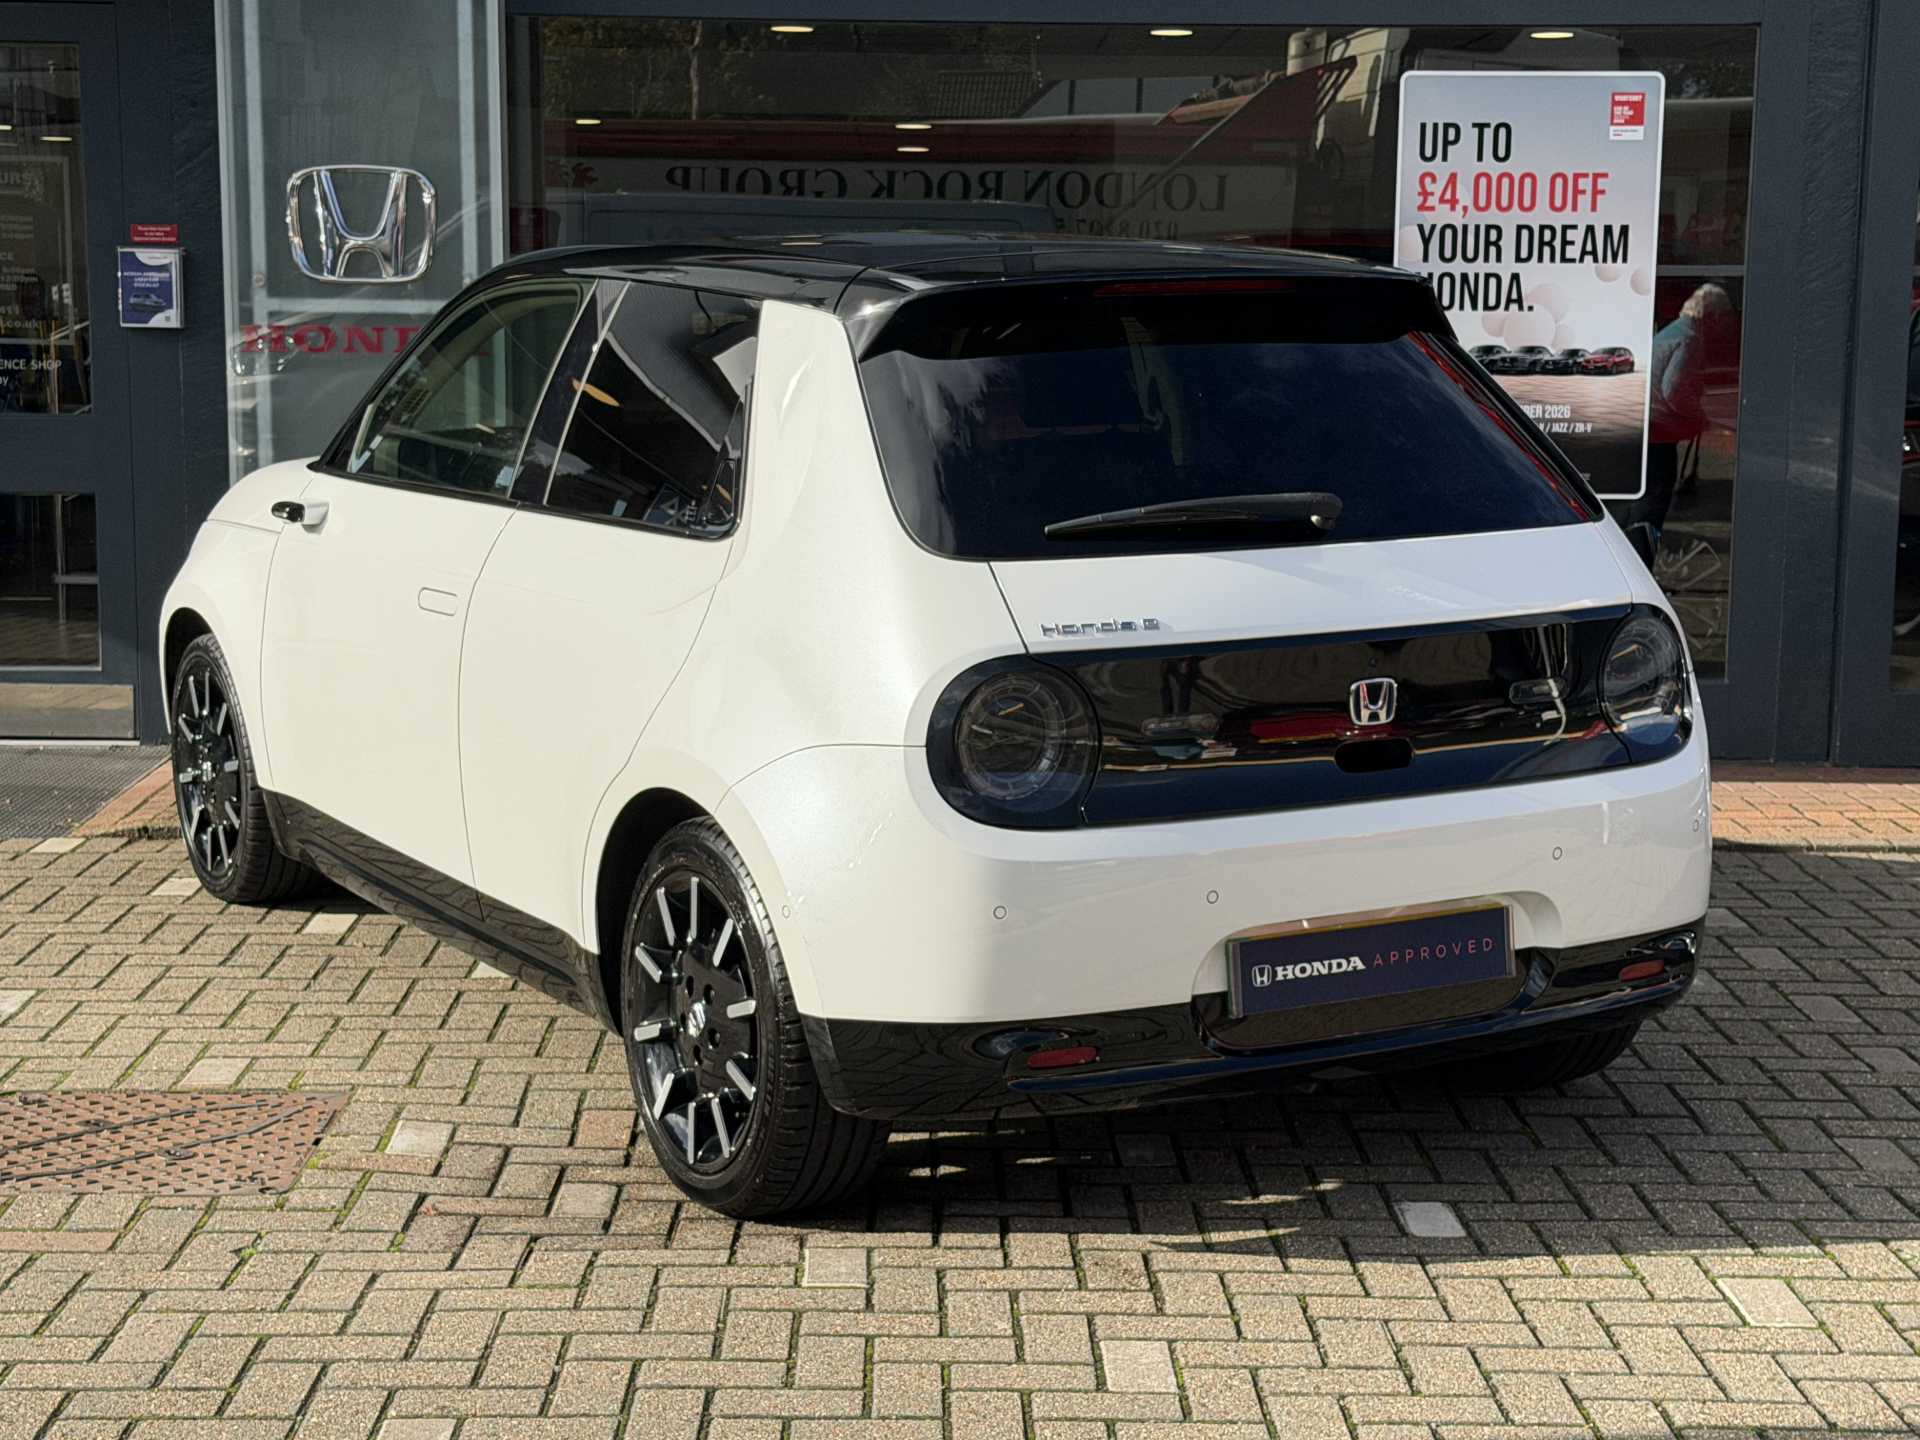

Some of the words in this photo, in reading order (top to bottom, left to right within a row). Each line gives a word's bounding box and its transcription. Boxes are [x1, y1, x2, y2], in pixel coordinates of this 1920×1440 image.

[1418, 122, 1461, 163] UP
[1472, 122, 1513, 164] TO
[1416, 172, 1538, 219] £4,000
[1548, 172, 1611, 214] OFF
[1416, 223, 1504, 265] YOUR
[1514, 223, 1631, 265] DREAM
[1416, 272, 1535, 312] ONDA.
[1040, 618, 1137, 637] Honda
[1274, 955, 1367, 982] HONDA
[1372, 936, 1495, 968] APPROVED
